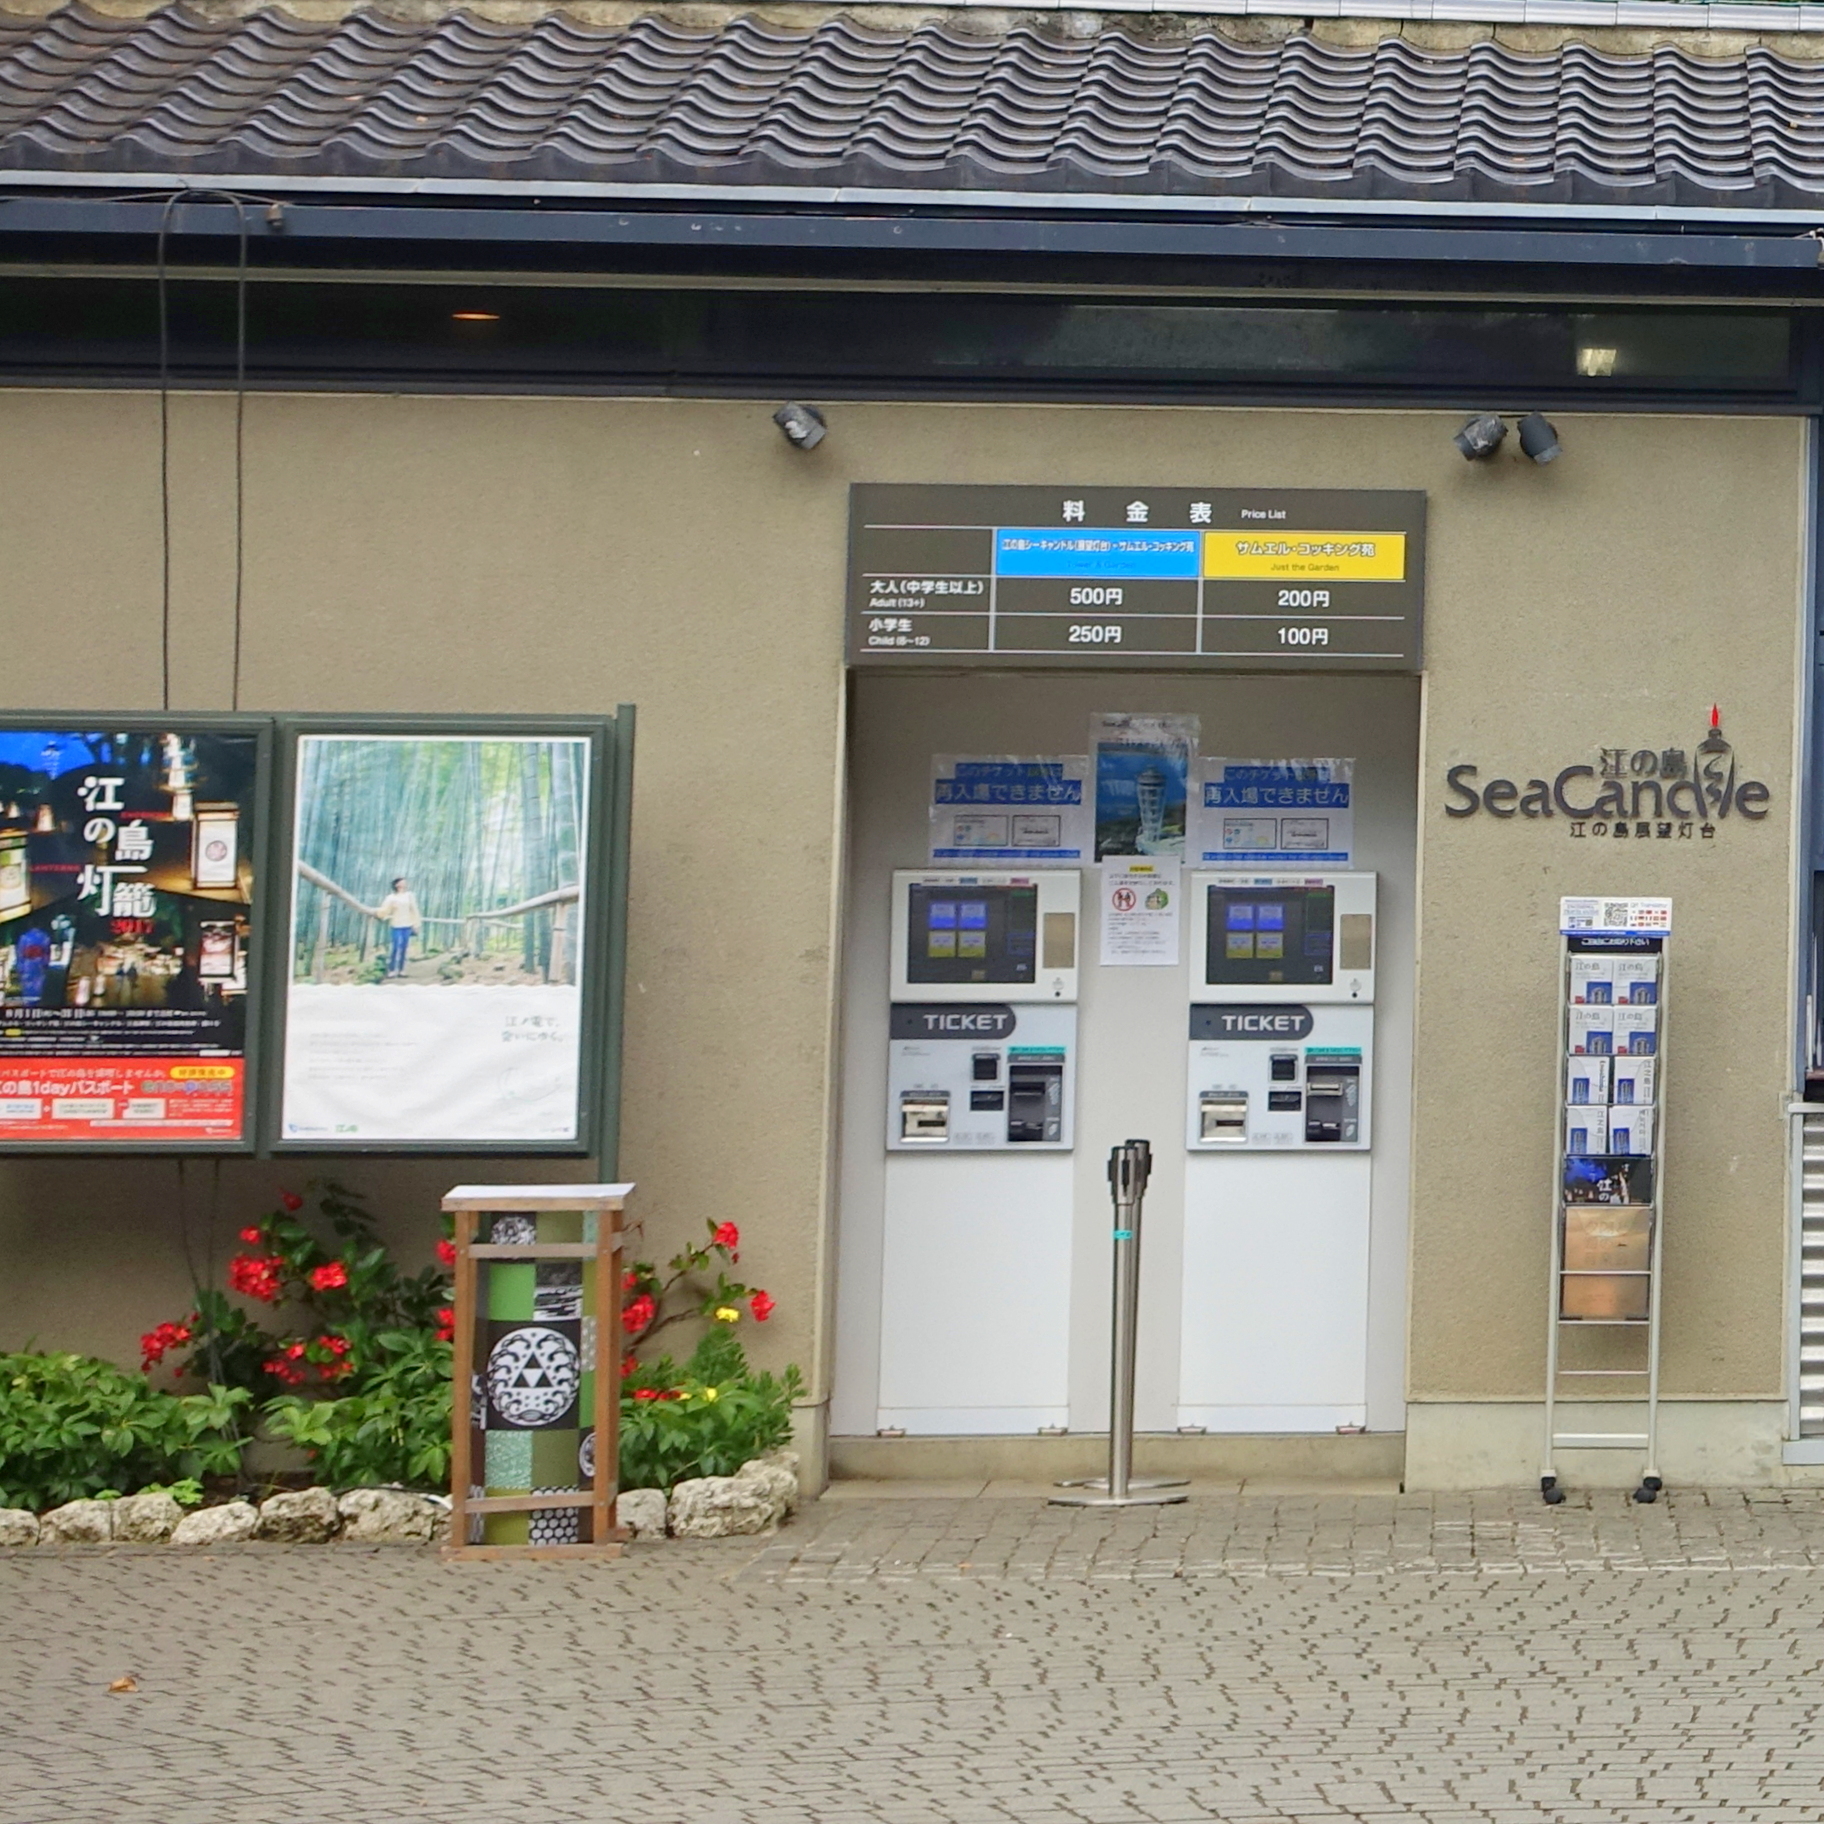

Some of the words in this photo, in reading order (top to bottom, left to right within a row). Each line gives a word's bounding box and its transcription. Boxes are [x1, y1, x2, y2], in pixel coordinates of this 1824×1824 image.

[1062, 499, 1212, 524] 料金表
[1241, 509, 1266, 520] Price
[1268, 509, 1287, 520] List
[1236, 541, 1375, 558] サムエル・コッキング苑
[1270, 563, 1288, 572] Just
[1291, 563, 1306, 572] the
[1308, 563, 1340, 573] Garden
[869, 579, 984, 595] 大人(中学生以上)
[868, 598, 897, 608] Adult
[1069, 587, 1123, 606] 500円
[1277, 589, 1330, 608] 200円
[868, 618, 912, 633] 小学生
[1067, 625, 1122, 644] 250円
[1277, 627, 1329, 646] 100円
[1599, 747, 1689, 778] 江の島
[936, 783, 1081, 802] 再入場できません
[1444, 746, 1771, 821] SeaCandle
[1206, 786, 1349, 805] 再入場できません
[1569, 822, 1717, 839] 江の島展望灯台
[111, 919, 154, 934] 2017
[923, 1013, 1008, 1031] TICKET
[1221, 1014, 1306, 1032] TICKET
[0, 1080, 134, 1096] の島1dayパスポート
